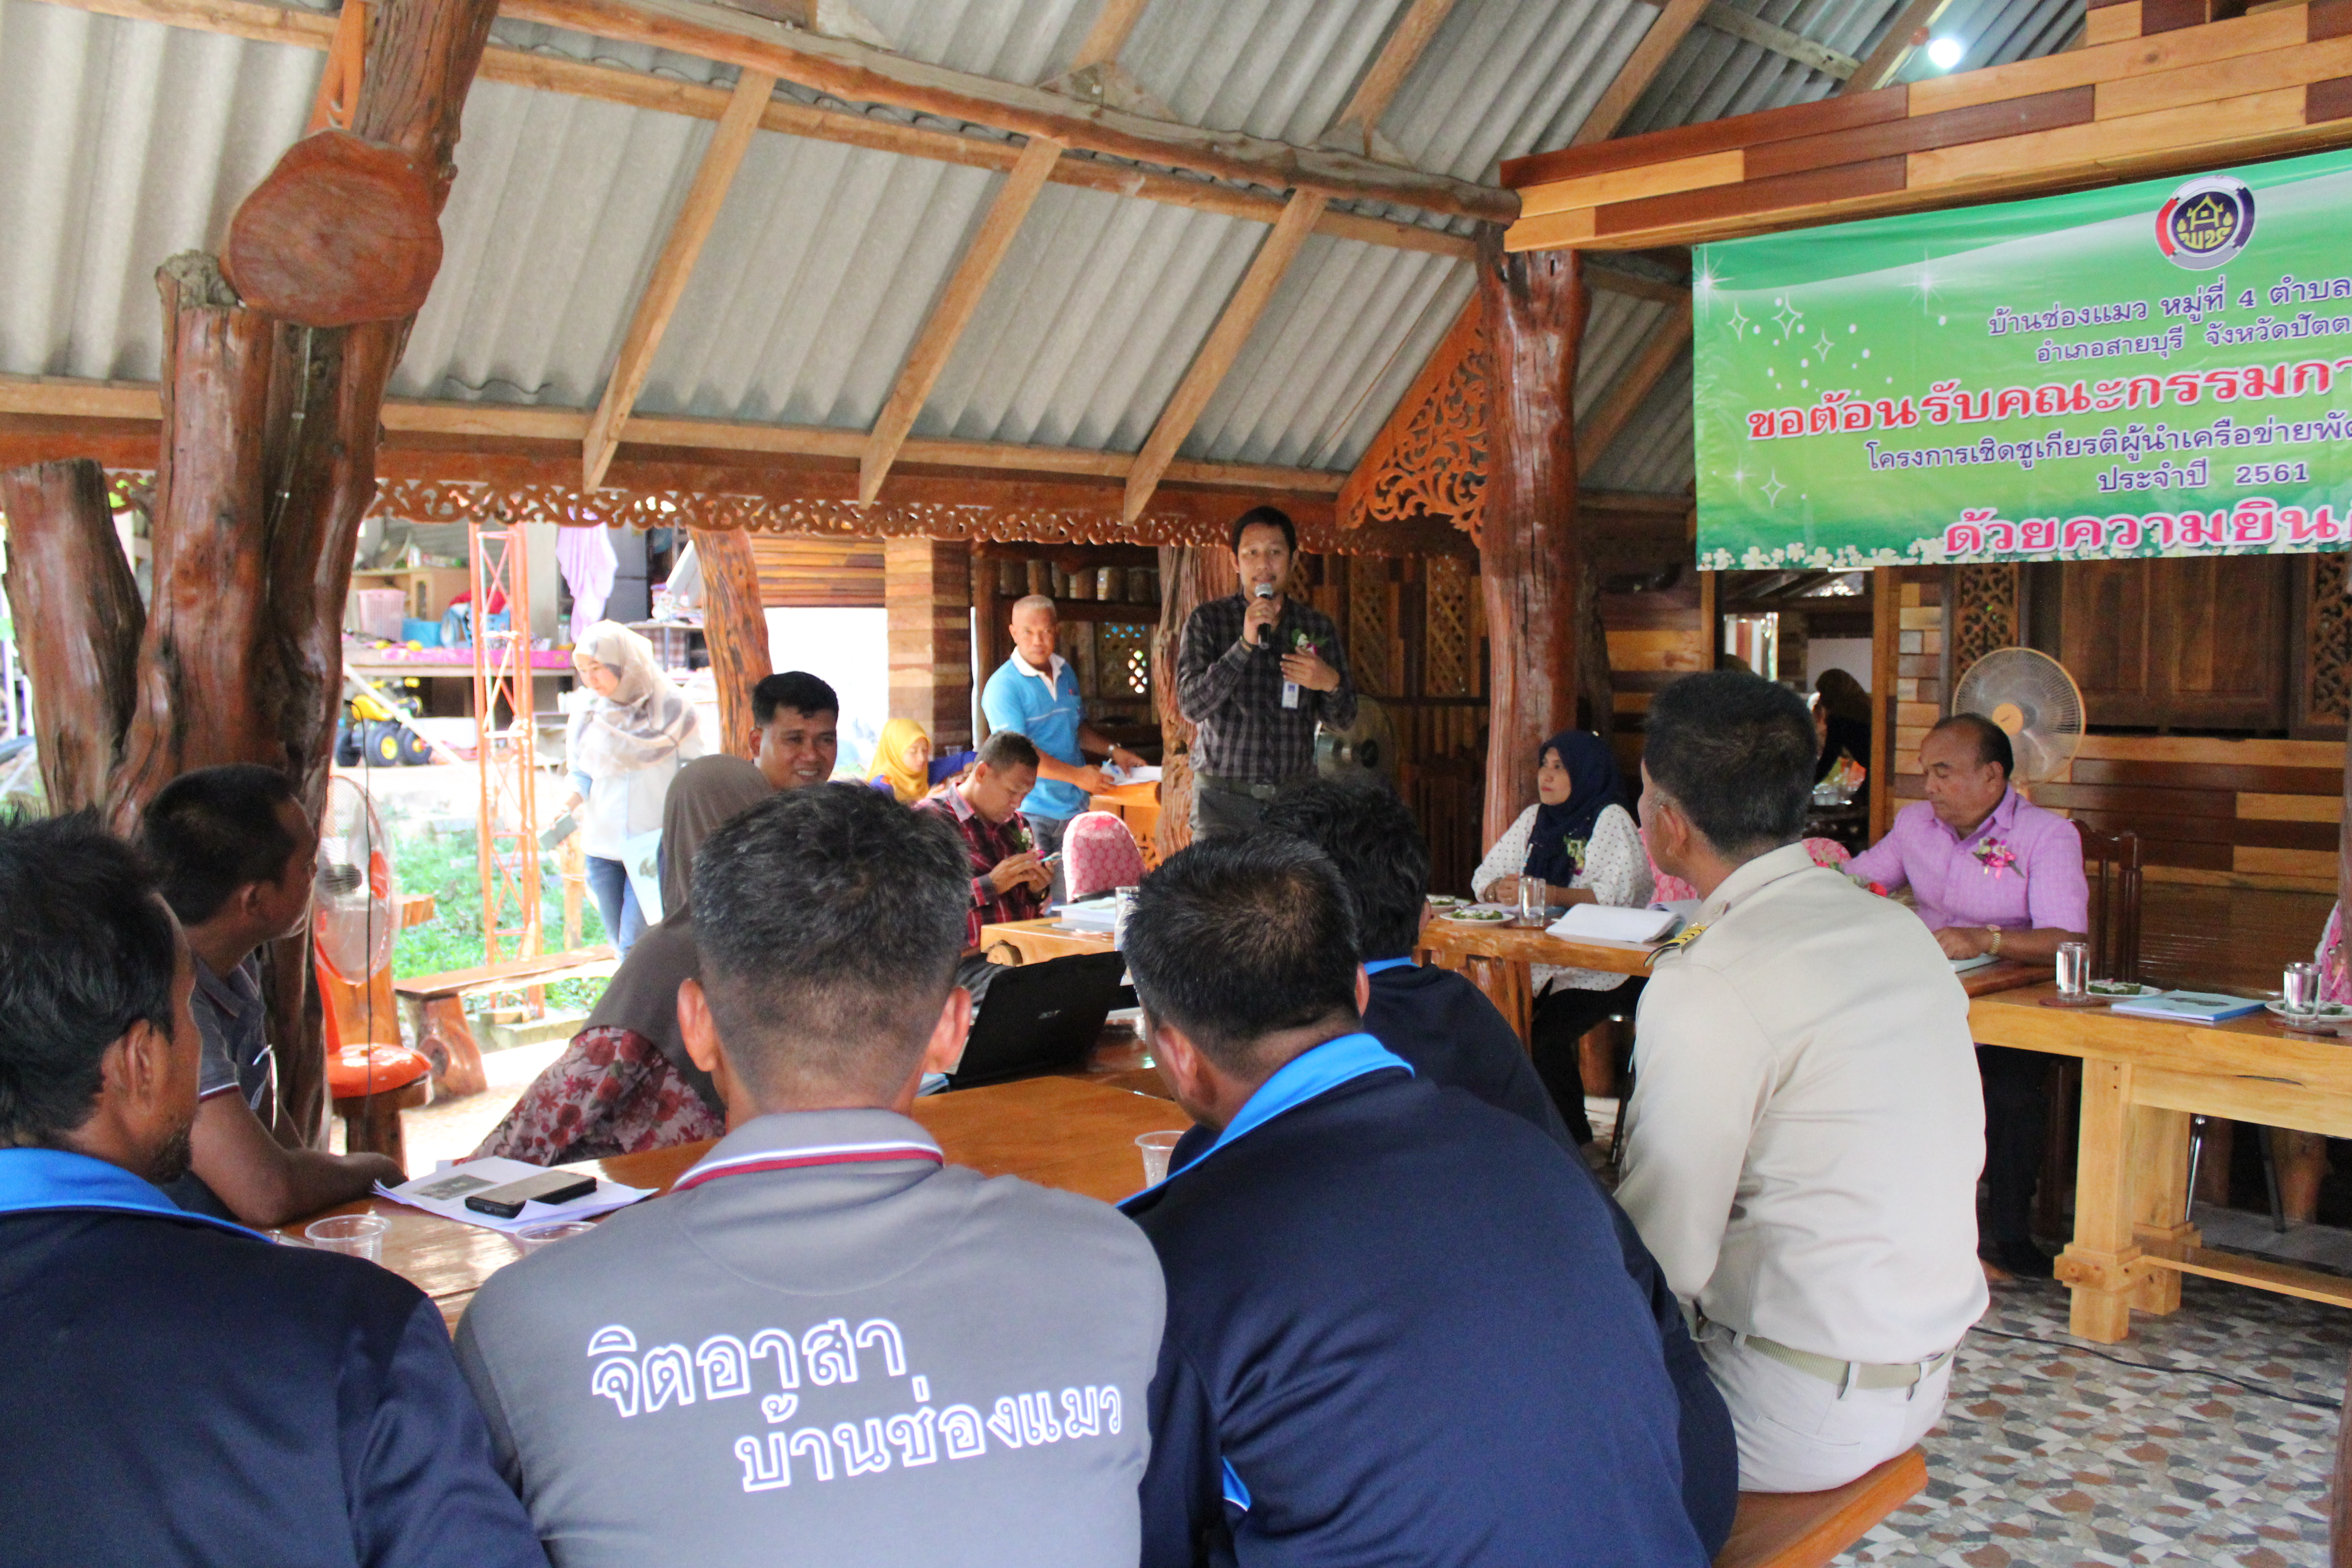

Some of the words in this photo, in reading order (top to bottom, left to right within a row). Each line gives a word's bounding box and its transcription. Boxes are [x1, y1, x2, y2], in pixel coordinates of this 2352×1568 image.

[1989, 299, 2147, 336] บ้านช่องแมว
[2161, 276, 2225, 323] หมู่ที่
[2238, 289, 2255, 307] 4
[2270, 276, 2350, 304] ตำบล
[2038, 327, 2184, 362] อำเภอสายบุรี
[2206, 314, 2349, 346] จังหวัดปัตต
[2099, 460, 2207, 491] ประจำปี
[2237, 464, 2306, 484] 2561
[1946, 500, 2352, 552] ด้วยความยิน
[588, 1318, 906, 1417] จิตอาสา
[734, 1376, 1122, 1492] บ้านช่องแมว
